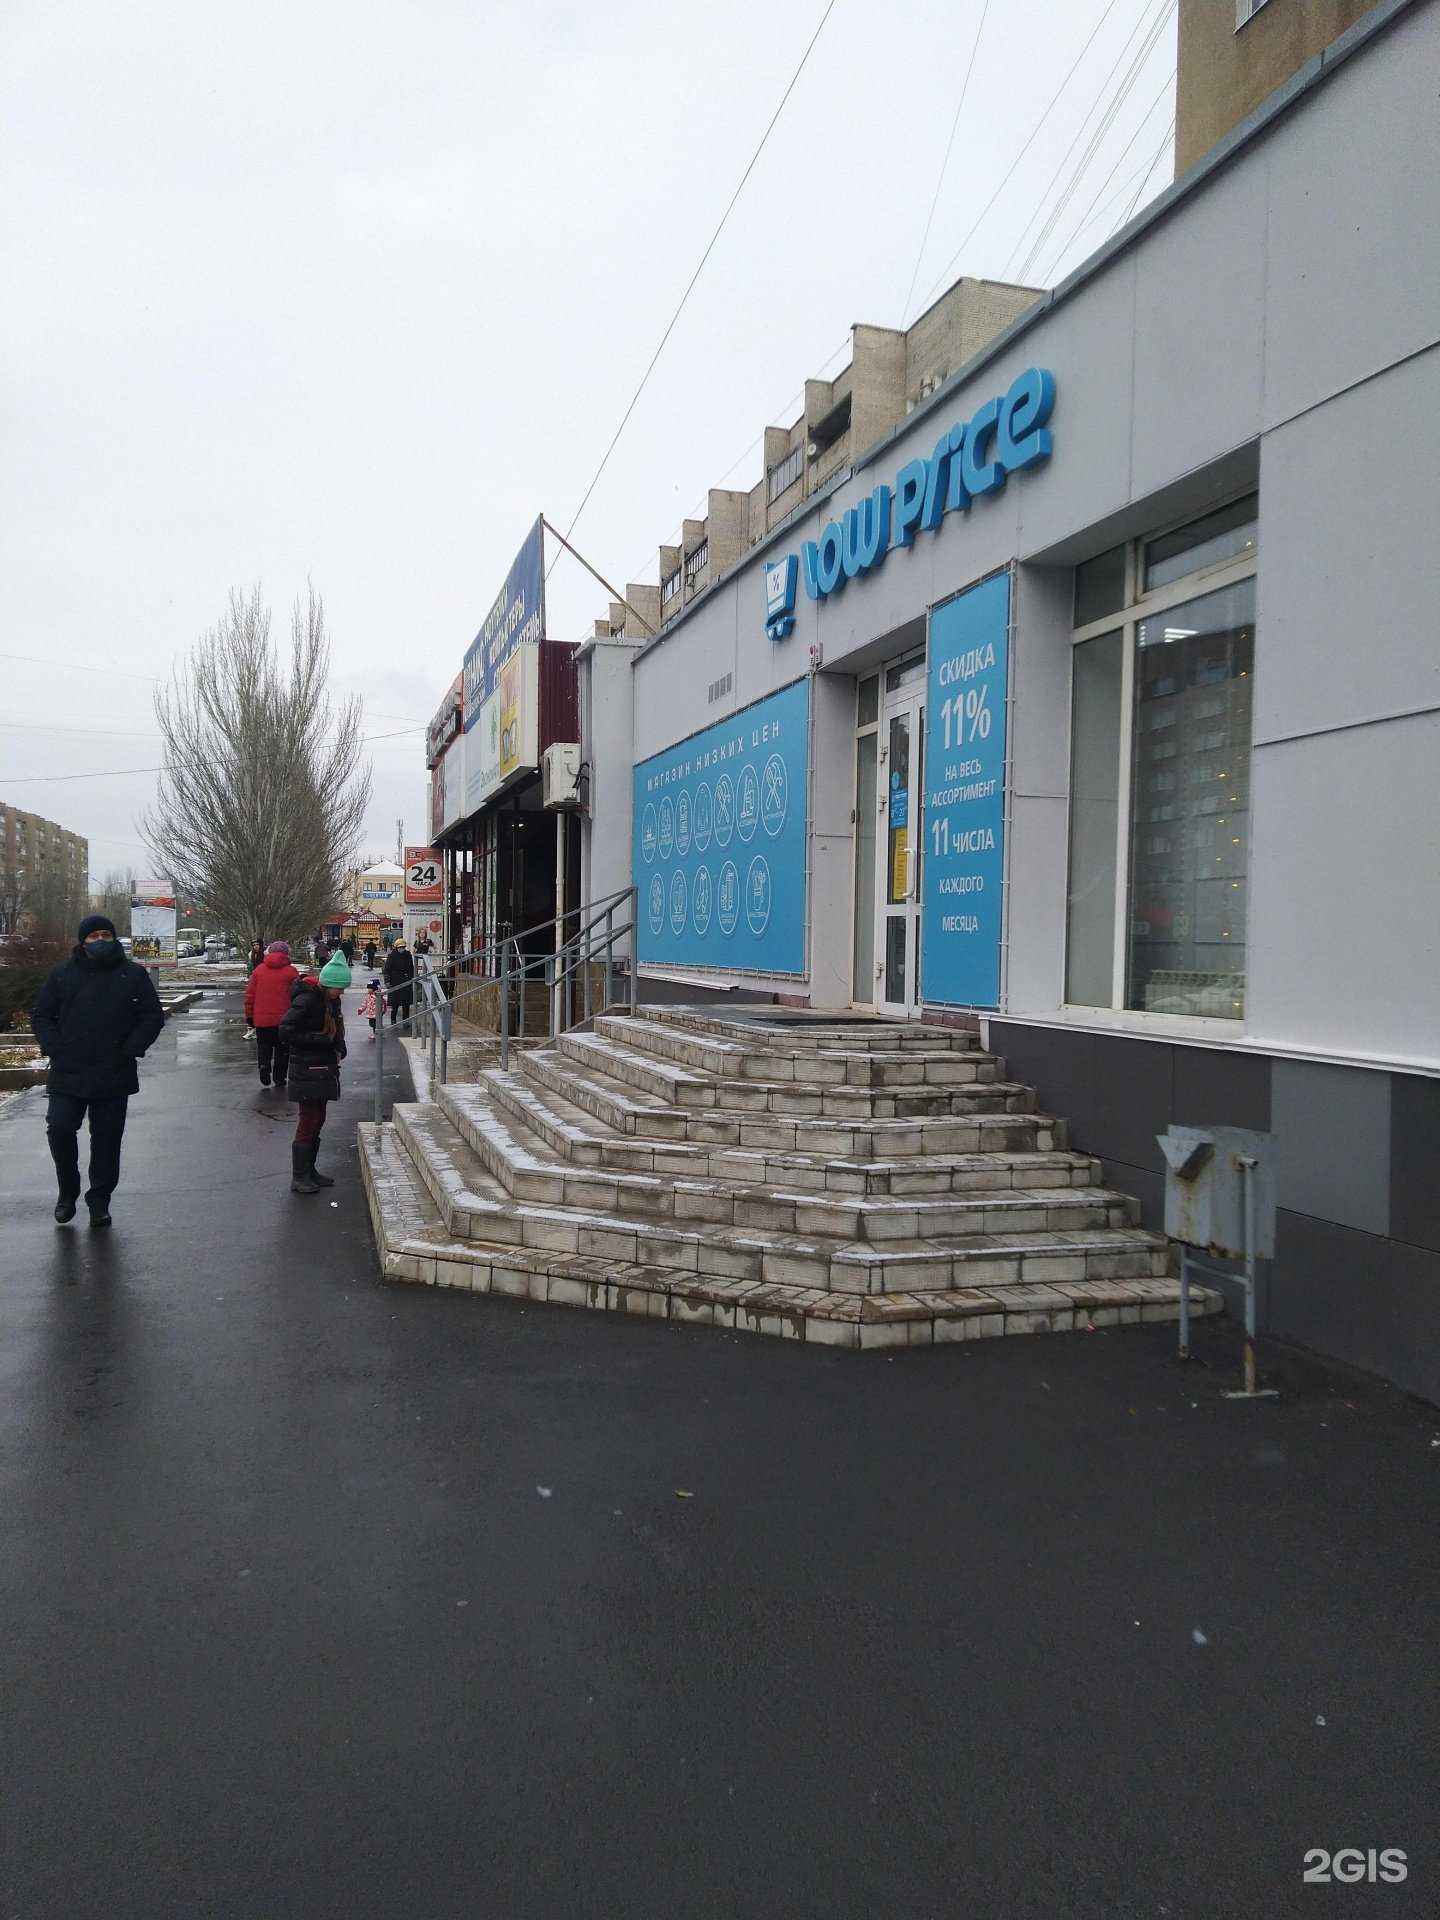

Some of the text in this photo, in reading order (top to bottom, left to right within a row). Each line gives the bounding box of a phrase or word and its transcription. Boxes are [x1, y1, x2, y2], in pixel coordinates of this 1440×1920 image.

[939, 641, 996, 687] СКИДКА
[941, 684, 991, 750] 11%
[647, 719, 780, 792] МАГАЗИН НИЗКИХ ЦЕН
[945, 758, 982, 782] НА ВЕСЬ
[931, 779, 997, 808] АССОРТИМЕНТ
[932, 817, 996, 856] 11 ЧИСЛА
[411, 866, 437, 882] 24
[939, 875, 984, 896] КАЖДОГО
[942, 915, 979, 935] МЕСЯЦА
